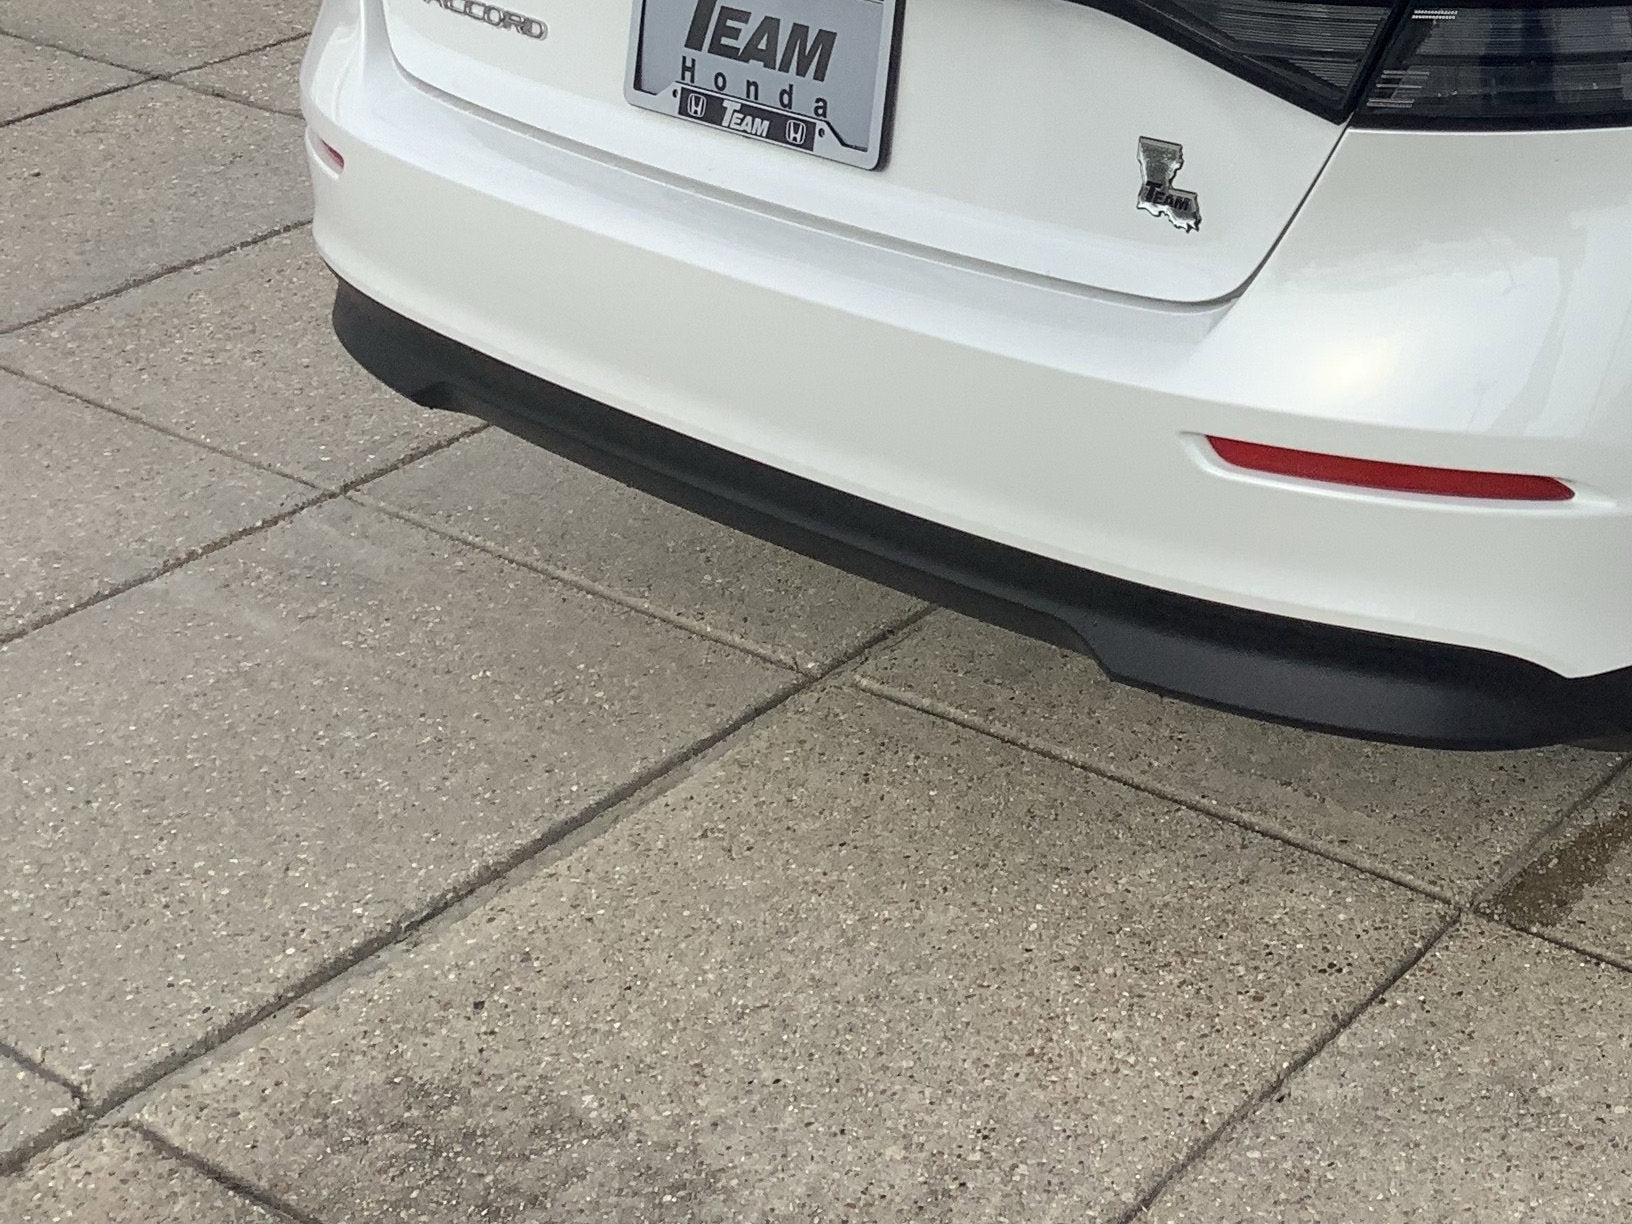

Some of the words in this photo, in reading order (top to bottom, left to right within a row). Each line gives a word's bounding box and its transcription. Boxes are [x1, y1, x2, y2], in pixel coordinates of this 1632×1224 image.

[680, 55, 828, 119] Honda
[720, 100, 771, 138] TEAM
[1145, 180, 1192, 211] TEAM
